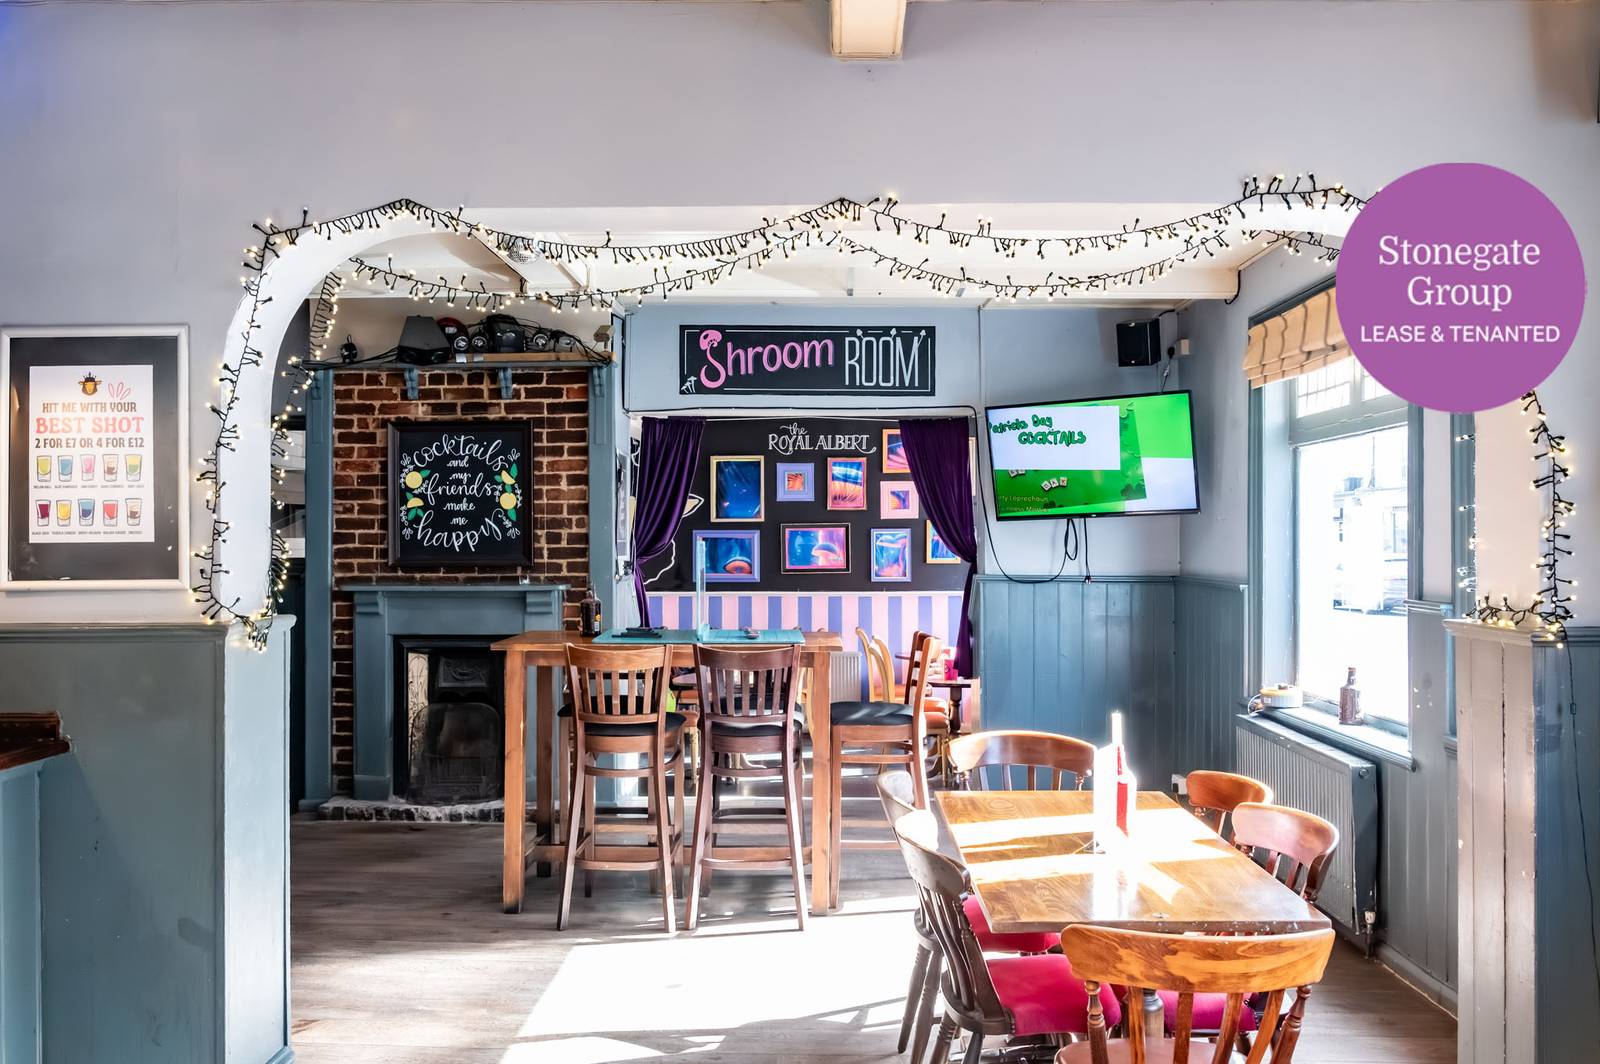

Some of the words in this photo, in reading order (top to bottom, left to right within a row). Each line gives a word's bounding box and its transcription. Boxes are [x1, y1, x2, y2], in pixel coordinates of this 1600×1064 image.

[699, 329, 833, 389] Shroom
[844, 334, 922, 387] ROOM
[42, 402, 58, 413] HIT
[62, 402, 77, 413] ME
[80, 402, 106, 413] WITH
[109, 401, 137, 413] YOUR
[35, 417, 83, 434] BEST
[91, 416, 144, 433] SHOT
[1031, 414, 1053, 428] Day
[780, 422, 808, 436] the
[35, 438, 41, 449] 2
[43, 438, 63, 449] FOR
[65, 438, 77, 448] £7
[79, 438, 93, 448] OR
[96, 438, 103, 448] 4
[106, 437, 126, 448] FOR
[128, 437, 145, 448] £12
[768, 434, 814, 455] ROYAL
[815, 434, 877, 453] ALBERT
[1018, 430, 1087, 447] COCKTAILS
[446, 456, 469, 468] and
[449, 472, 471, 484] my
[423, 472, 499, 506] friends
[443, 497, 476, 512] make
[450, 516, 468, 525] me
[413, 508, 503, 552] happy
